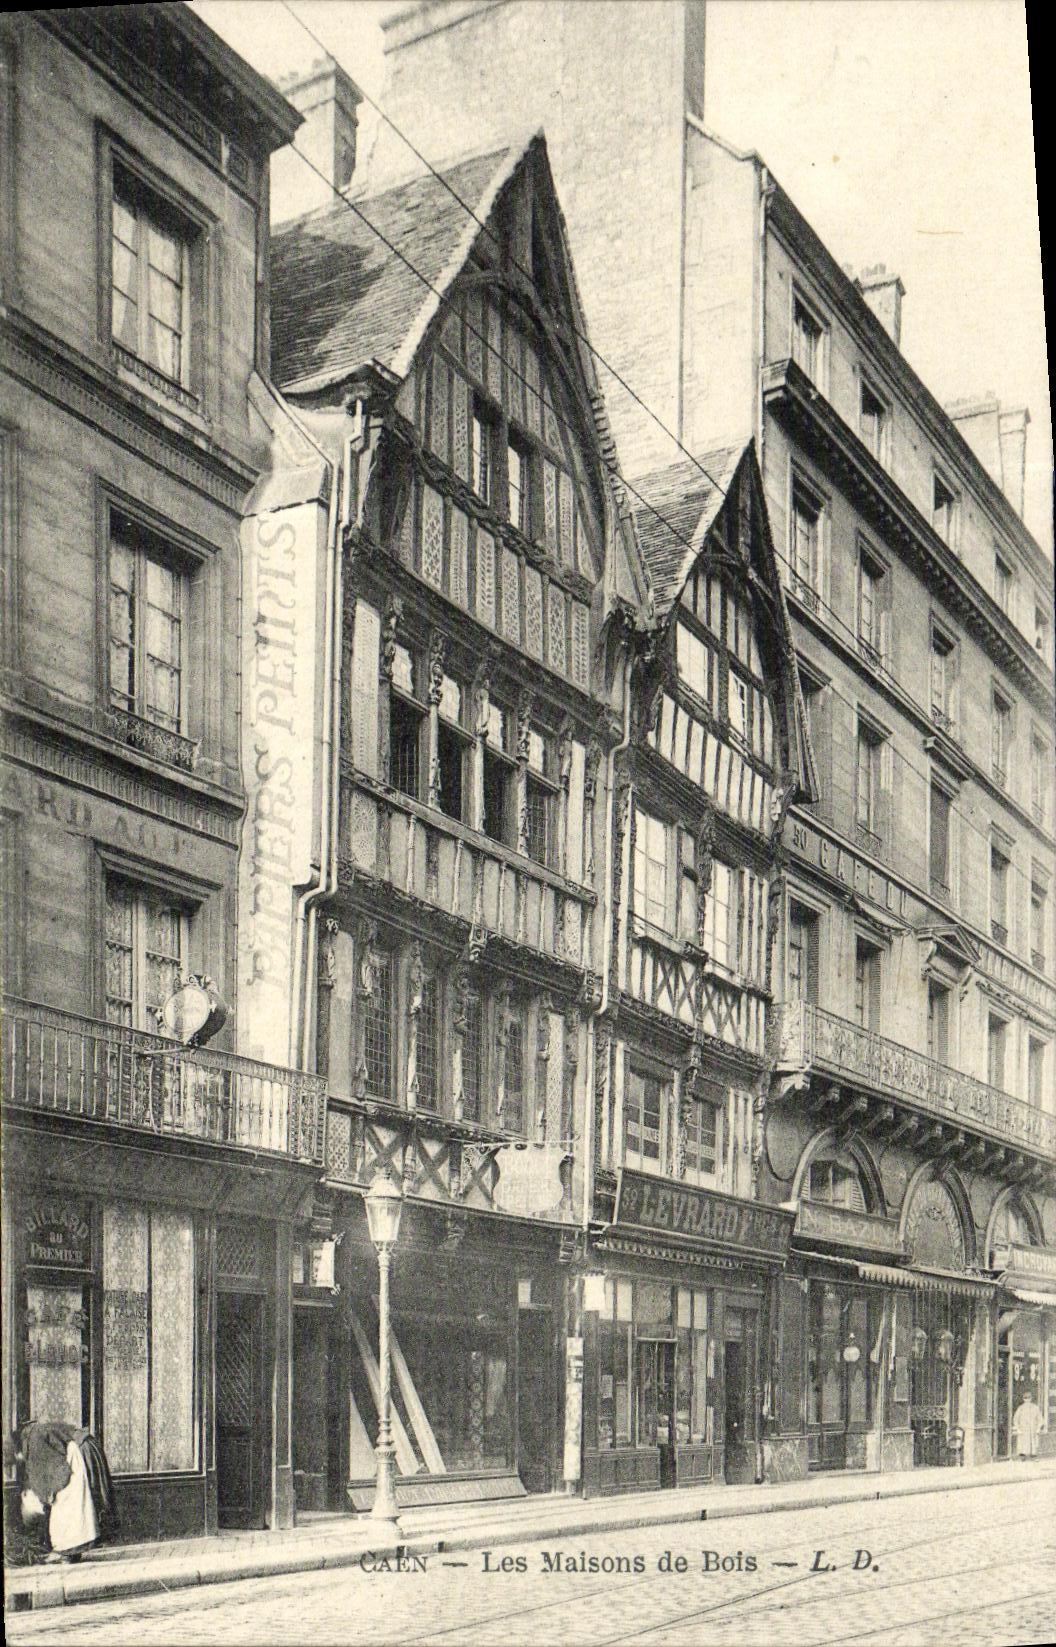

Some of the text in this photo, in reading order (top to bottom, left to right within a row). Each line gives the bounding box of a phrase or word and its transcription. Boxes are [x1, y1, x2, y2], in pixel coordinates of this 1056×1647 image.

[249, 517, 298, 736] PEINTS
[25, 1207, 89, 1239] BILLARD
[30, 1242, 83, 1263] PREMIER
